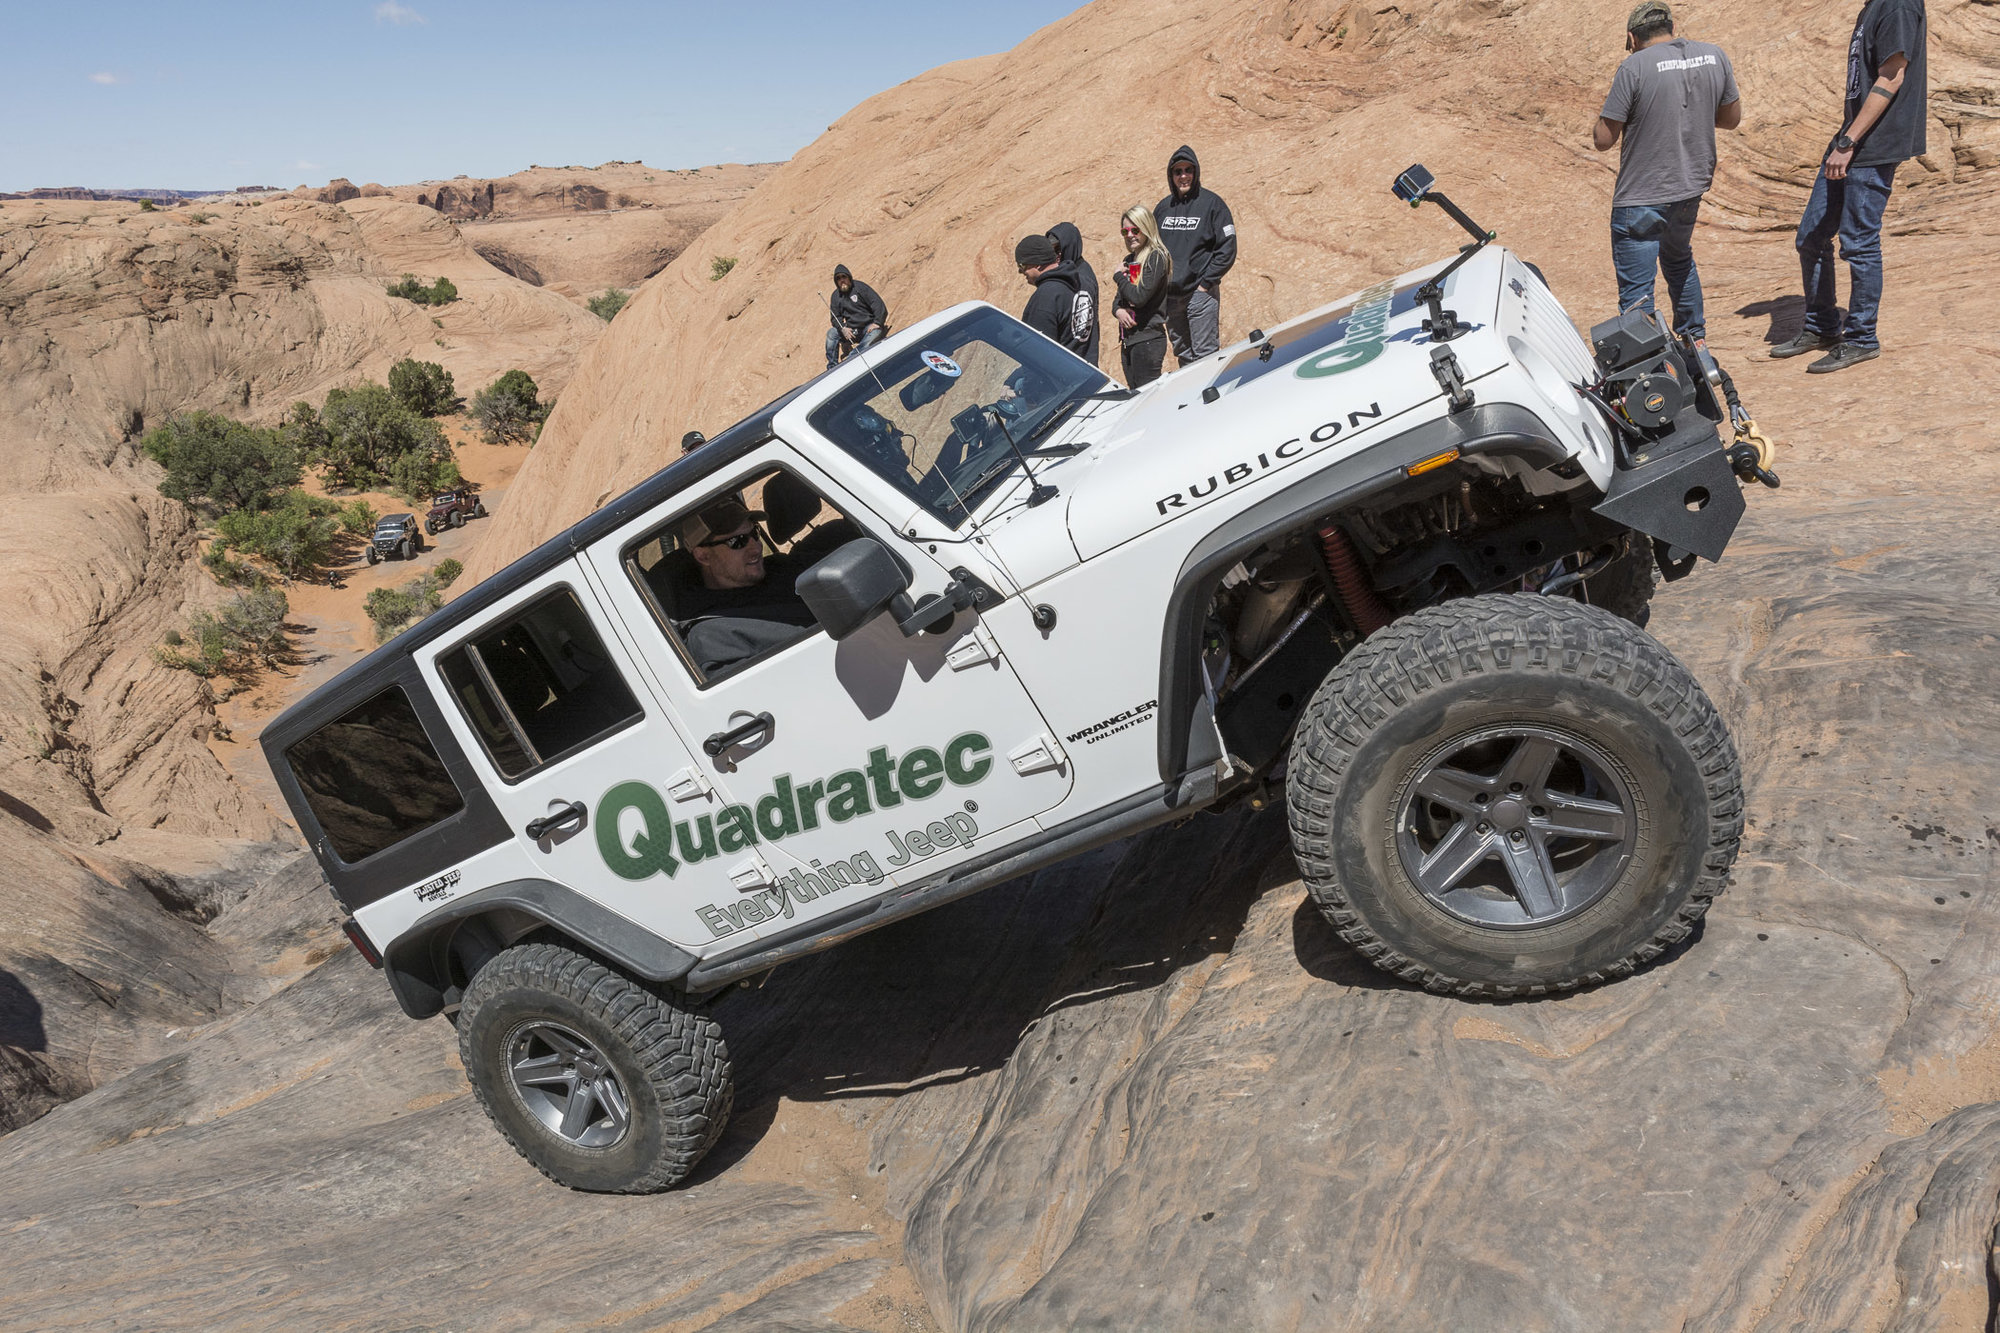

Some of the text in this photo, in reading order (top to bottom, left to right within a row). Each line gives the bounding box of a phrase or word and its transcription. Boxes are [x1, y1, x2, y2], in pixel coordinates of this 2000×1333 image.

[1155, 402, 1383, 516] RUBICON
[1066, 699, 1159, 743] WRANGLER
[1086, 713, 1153, 745] UNLIMITED
[594, 730, 995, 882] Quadratec
[413, 878, 444, 898] TWISTED
[444, 869, 461, 886] JEEP
[695, 850, 885, 937] Everything
